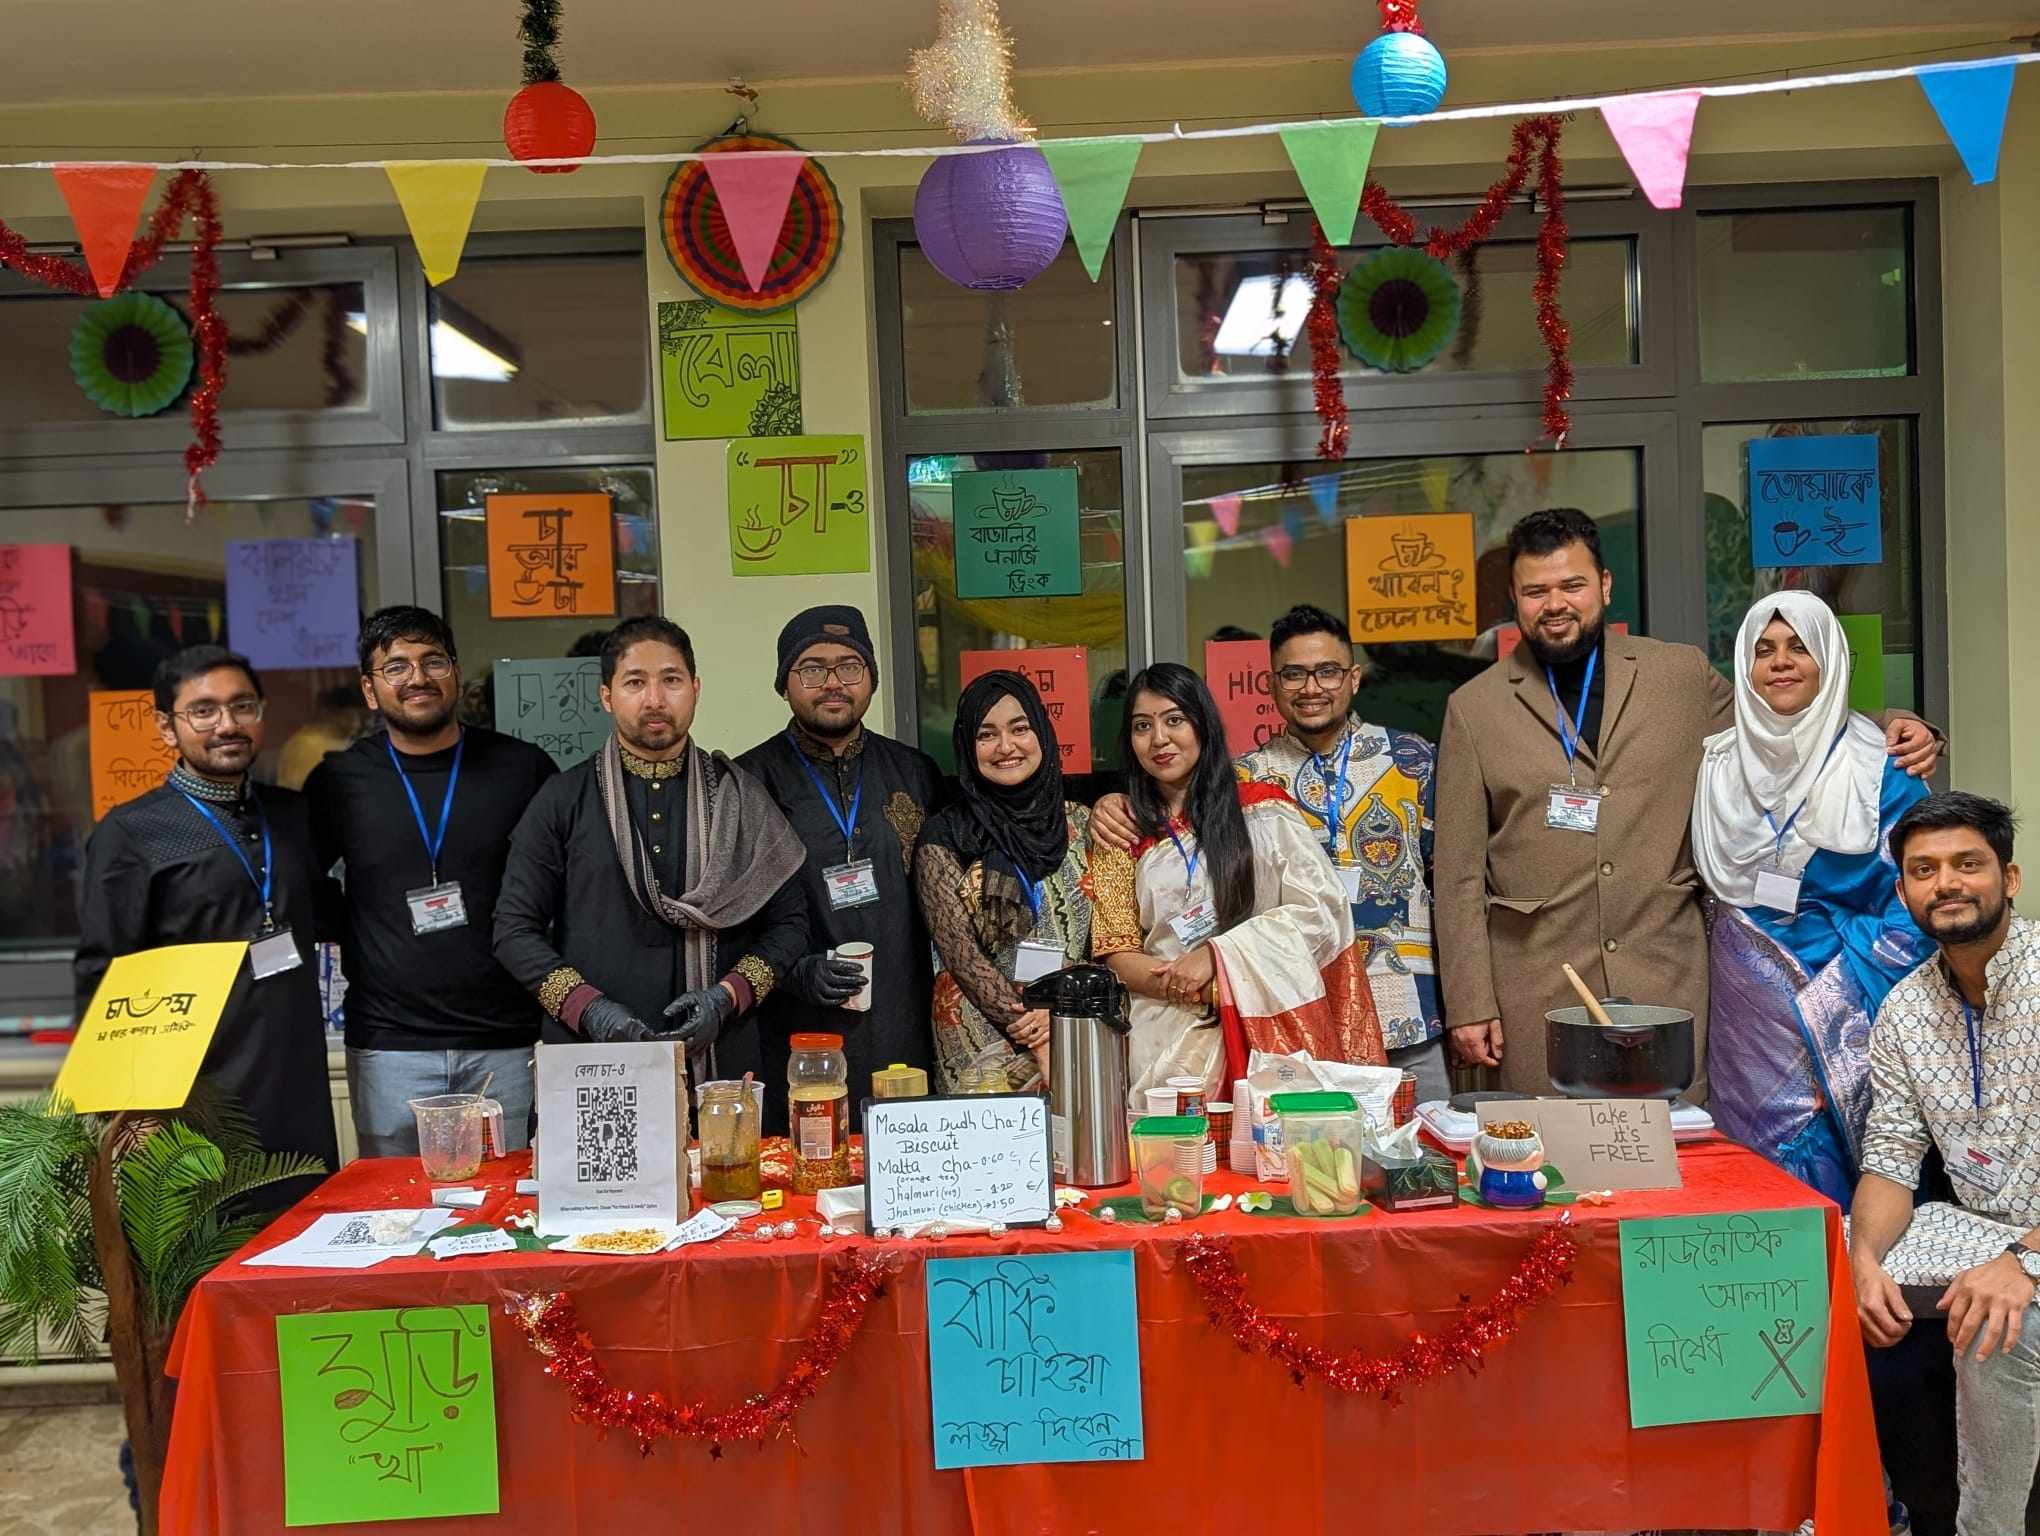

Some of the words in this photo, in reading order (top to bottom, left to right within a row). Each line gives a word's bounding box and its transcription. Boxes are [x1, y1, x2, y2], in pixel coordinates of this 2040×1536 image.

[670, 324, 798, 407] বেলা
[1758, 468, 1875, 503] তোমাকে
[1256, 703, 1275, 715] ON
[1253, 722, 1288, 748] CH
[876, 1113, 928, 1135] Masala
[936, 1110, 977, 1132] Dudh
[1577, 1102, 1629, 1126] Take
[1640, 1103, 1651, 1124] 1
[896, 1137, 960, 1154] Biscuit
[1613, 1125, 1641, 1143] it's
[1589, 1144, 1654, 1163] FREE
[878, 1159, 921, 1175] Malta
[1632, 1215, 1790, 1273] রাজনৈতিক
[1698, 1278, 1808, 1312] আলাপ
[1645, 1323, 1730, 1379] নিষেধ
[941, 1421, 1022, 1456] লজ্জা
[1031, 1407, 1120, 1447] দিবেন
[1086, 1436, 1142, 1459] না
